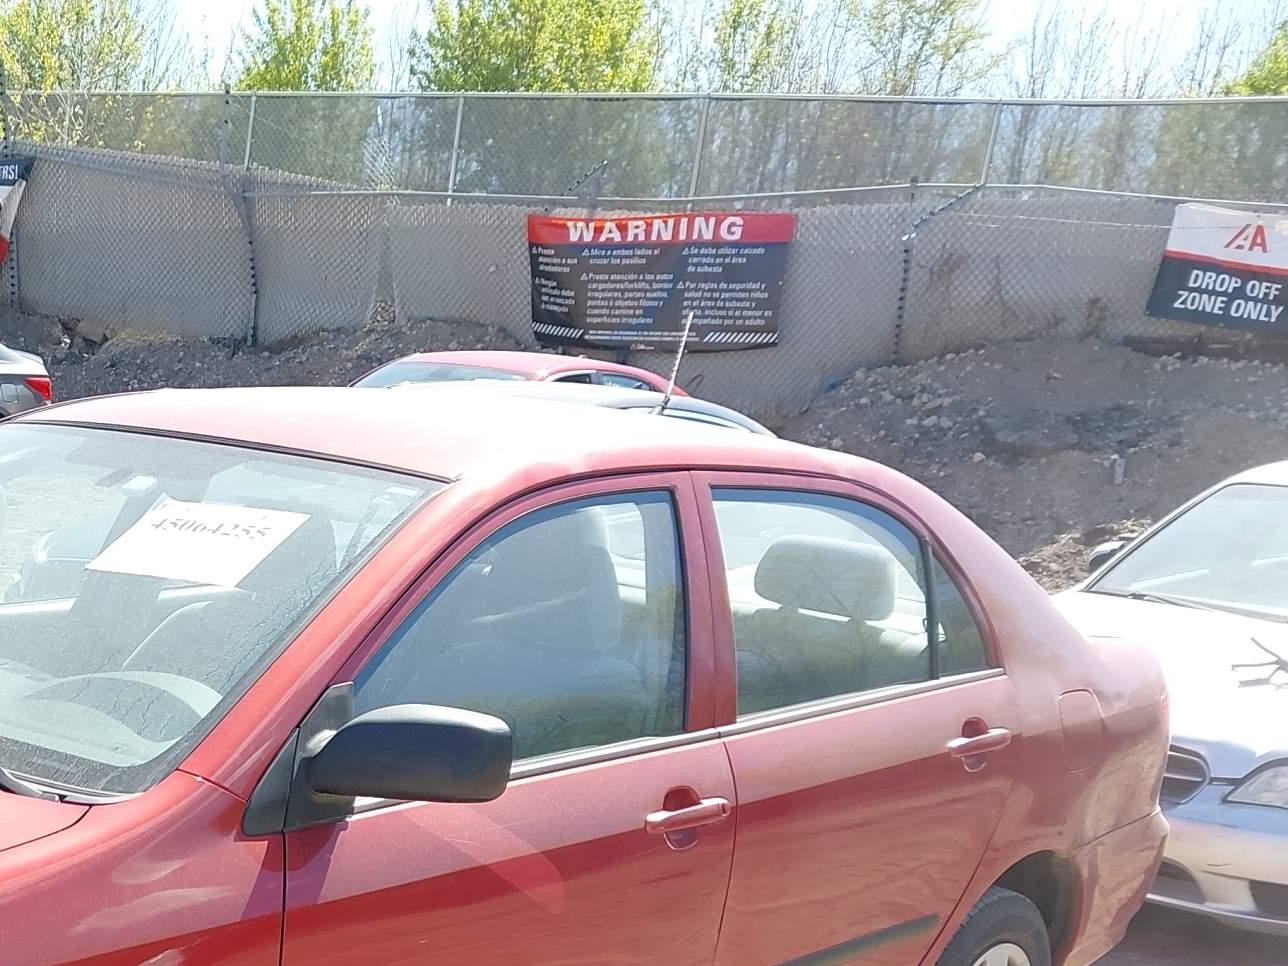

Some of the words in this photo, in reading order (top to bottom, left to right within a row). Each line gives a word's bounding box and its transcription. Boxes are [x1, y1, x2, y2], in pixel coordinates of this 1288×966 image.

[568, 216, 744, 241] WARNING
[698, 282, 717, 290] reglas
[729, 281, 760, 290] seguridad
[761, 283, 766, 291] y
[1188, 269, 1242, 293] DROP
[1246, 280, 1283, 300] OFF
[624, 291, 644, 299] partes
[721, 291, 749, 299] permiten
[1173, 290, 1227, 314] ZONE
[1230, 299, 1284, 323] ONLY
[586, 316, 620, 324] superficies
[621, 317, 653, 325] irregulares
